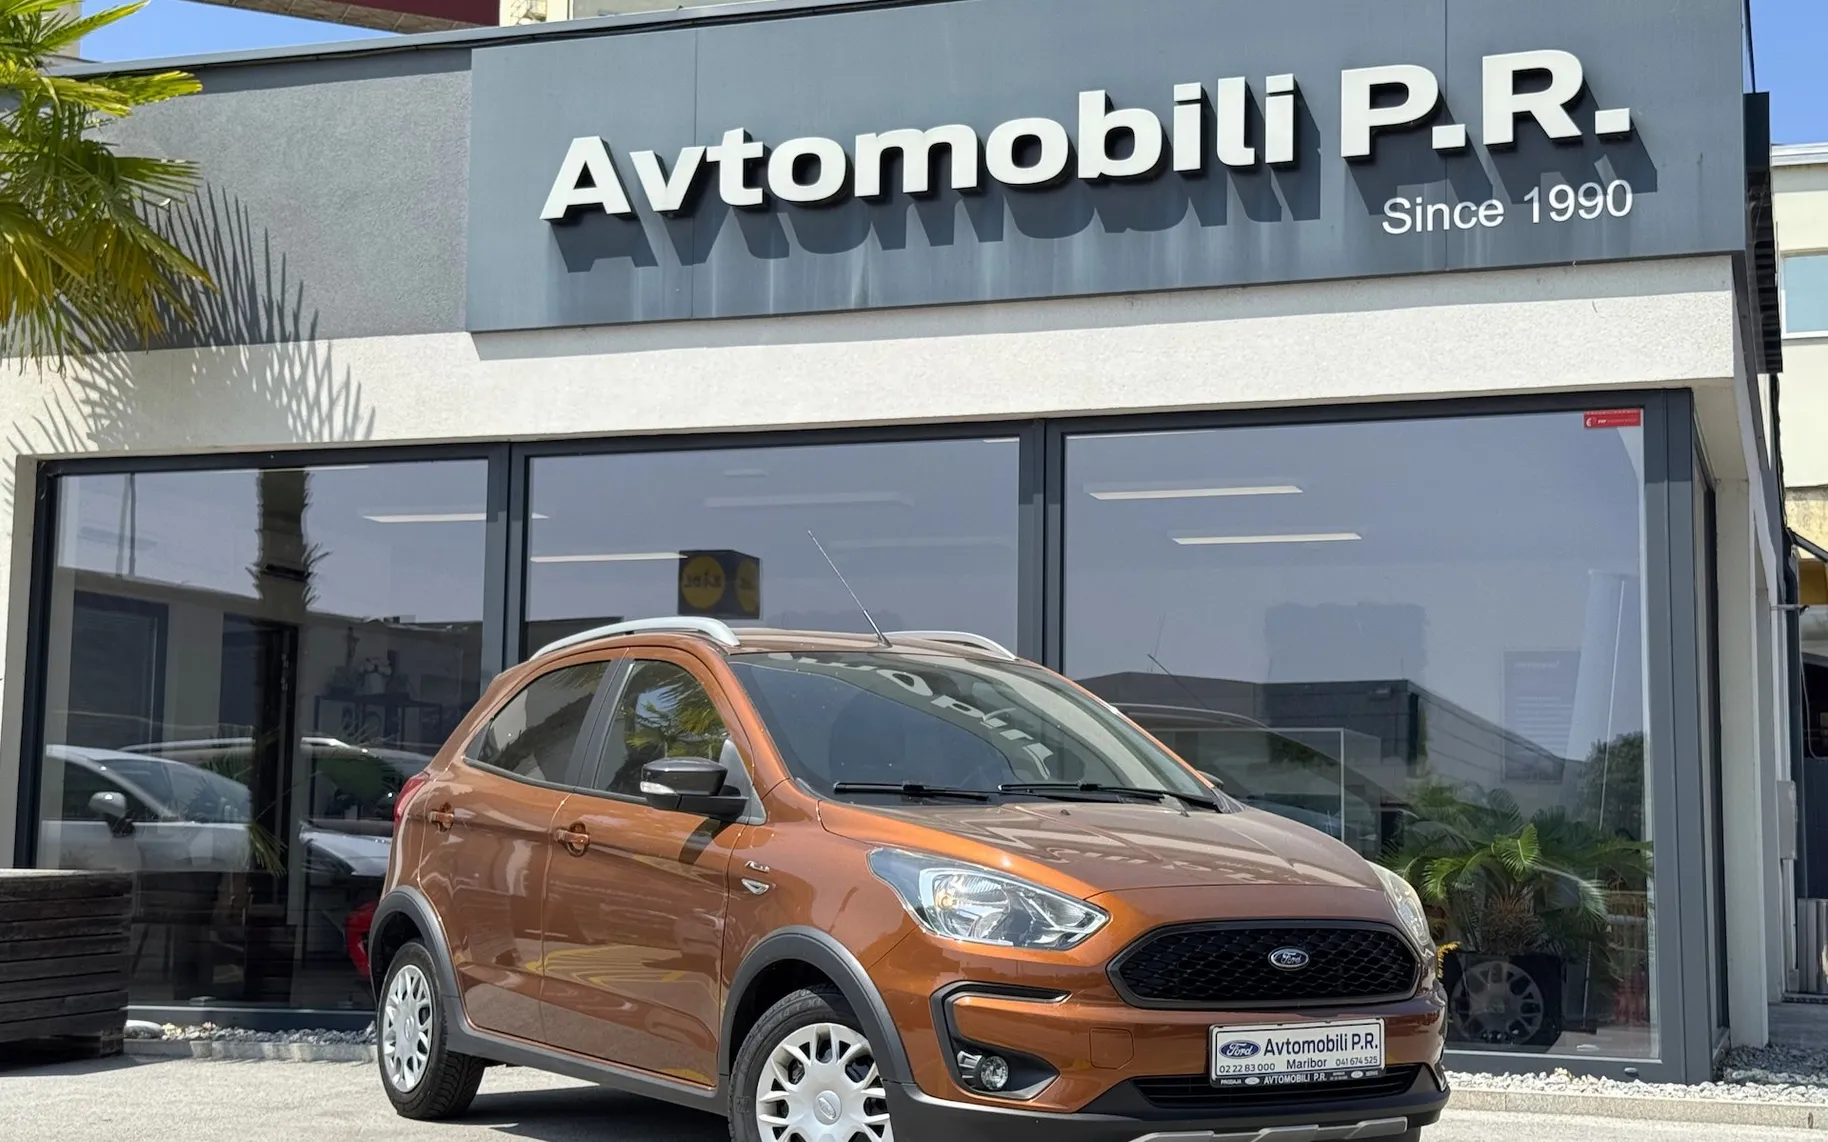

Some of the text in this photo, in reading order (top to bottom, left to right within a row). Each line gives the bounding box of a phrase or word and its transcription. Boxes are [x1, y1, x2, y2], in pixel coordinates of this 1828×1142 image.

[539, 49, 1631, 221] Avtomobili P.R.
[1382, 179, 1633, 235] Since 1990
[1264, 1032, 1379, 1056] Avtomobili P.R.
[1219, 1065, 1231, 1073] 02
[1244, 1064, 1256, 1072] 83
[1257, 1063, 1276, 1071] 000
[1286, 1057, 1328, 1070] Maribor
[1336, 1056, 1378, 1067] 041 674 525
[1263, 1074, 1310, 1084] AVTOMOBILI
[1313, 1073, 1327, 1081] P.R.
